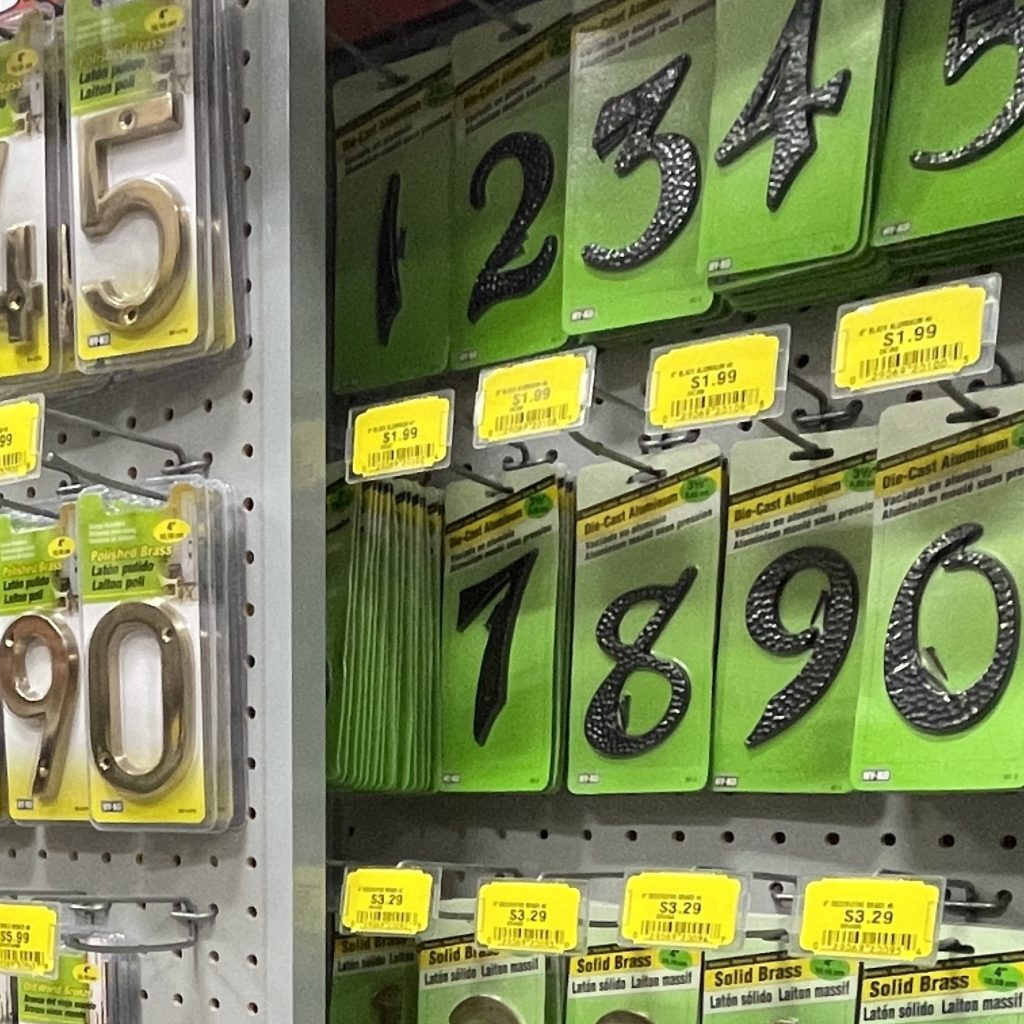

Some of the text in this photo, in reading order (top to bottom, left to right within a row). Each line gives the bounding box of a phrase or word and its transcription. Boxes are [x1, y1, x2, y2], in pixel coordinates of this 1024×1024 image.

[714, 0, 852, 213] 4
[582, 53, 701, 274] 3
[80, 92, 192, 335] 5
[467, 131, 558, 325] 2
[377, 173, 403, 347] 1
[883, 323, 937, 347] $1.99
[690, 369, 737, 389] $1.99
[513, 387, 551, 406] $1.99
[383, 427, 418, 444] $1.99
[882, 438, 1008, 489] Die-Cast Aluminum
[734, 480, 841, 522] Die-Cast Aluminum
[584, 509, 625, 535] Die-Cast
[884, 522, 1023, 736] 0
[455, 548, 540, 747] 7
[744, 545, 860, 748] 9
[584, 565, 699, 759] 8
[88, 601, 195, 796] 0
[370, 893, 403, 906] $3.29
[659, 901, 702, 915] $3.29
[509, 909, 547, 922] $3.29
[844, 909, 894, 924] $3.29
[0, 930, 30, 945] $5.99
[342, 938, 370, 953] Solid
[428, 948, 461, 966] Solid
[577, 955, 652, 973] Solid Brass
[714, 965, 803, 987] Solid Brass
[869, 974, 970, 998] Solid Brass
[710, 980, 851, 1009] Latón sólido Laiton massif
[863, 992, 1023, 1021] Latón sólido Laiton massif
